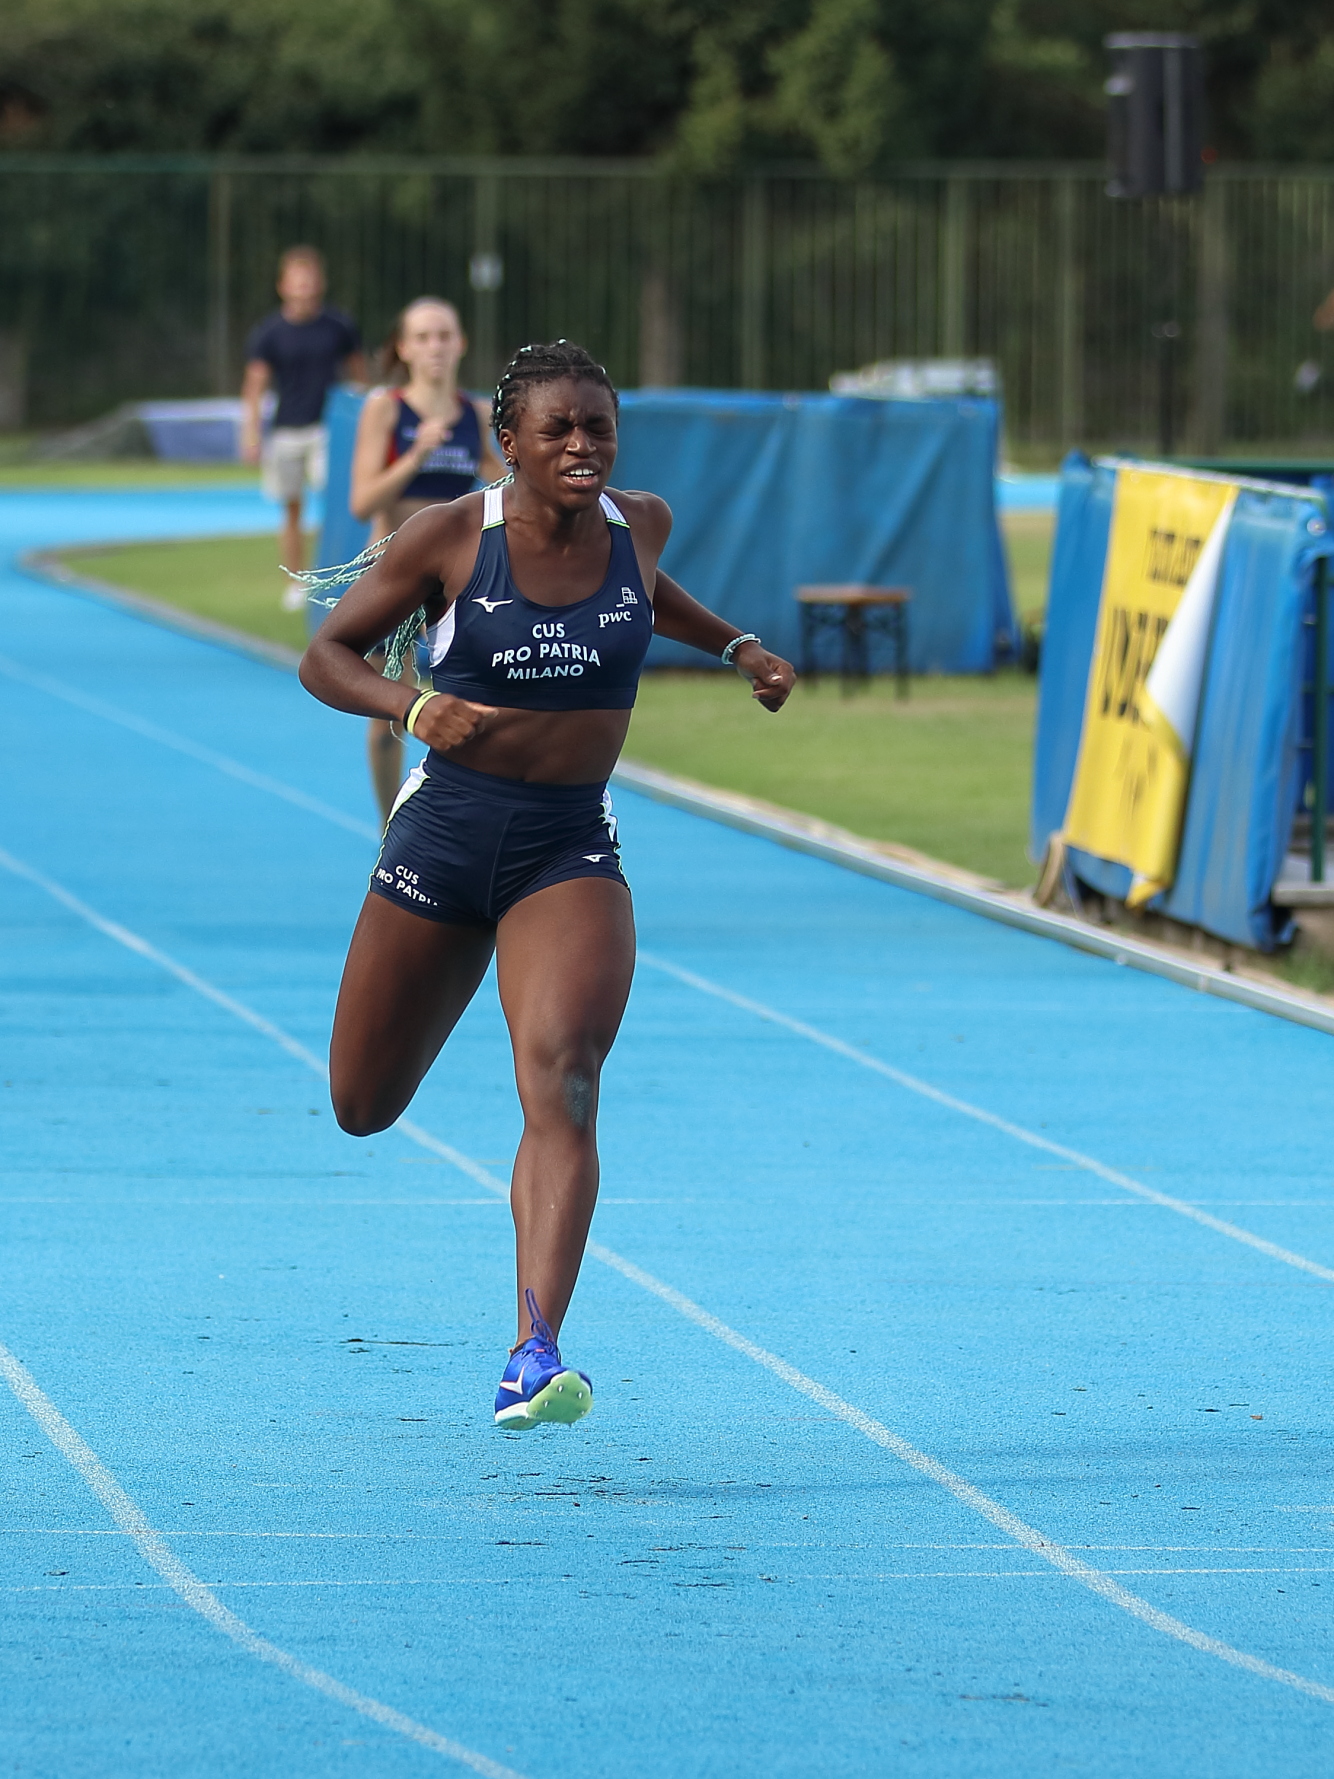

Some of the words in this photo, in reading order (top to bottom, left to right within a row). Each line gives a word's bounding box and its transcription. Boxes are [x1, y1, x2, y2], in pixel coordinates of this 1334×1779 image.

[598, 610, 632, 628] pwc
[532, 623, 565, 639] CUS
[491, 646, 531, 667] PRO
[539, 642, 601, 667] PATRIA
[506, 664, 584, 680] MILANO
[395, 865, 419, 885] CUS
